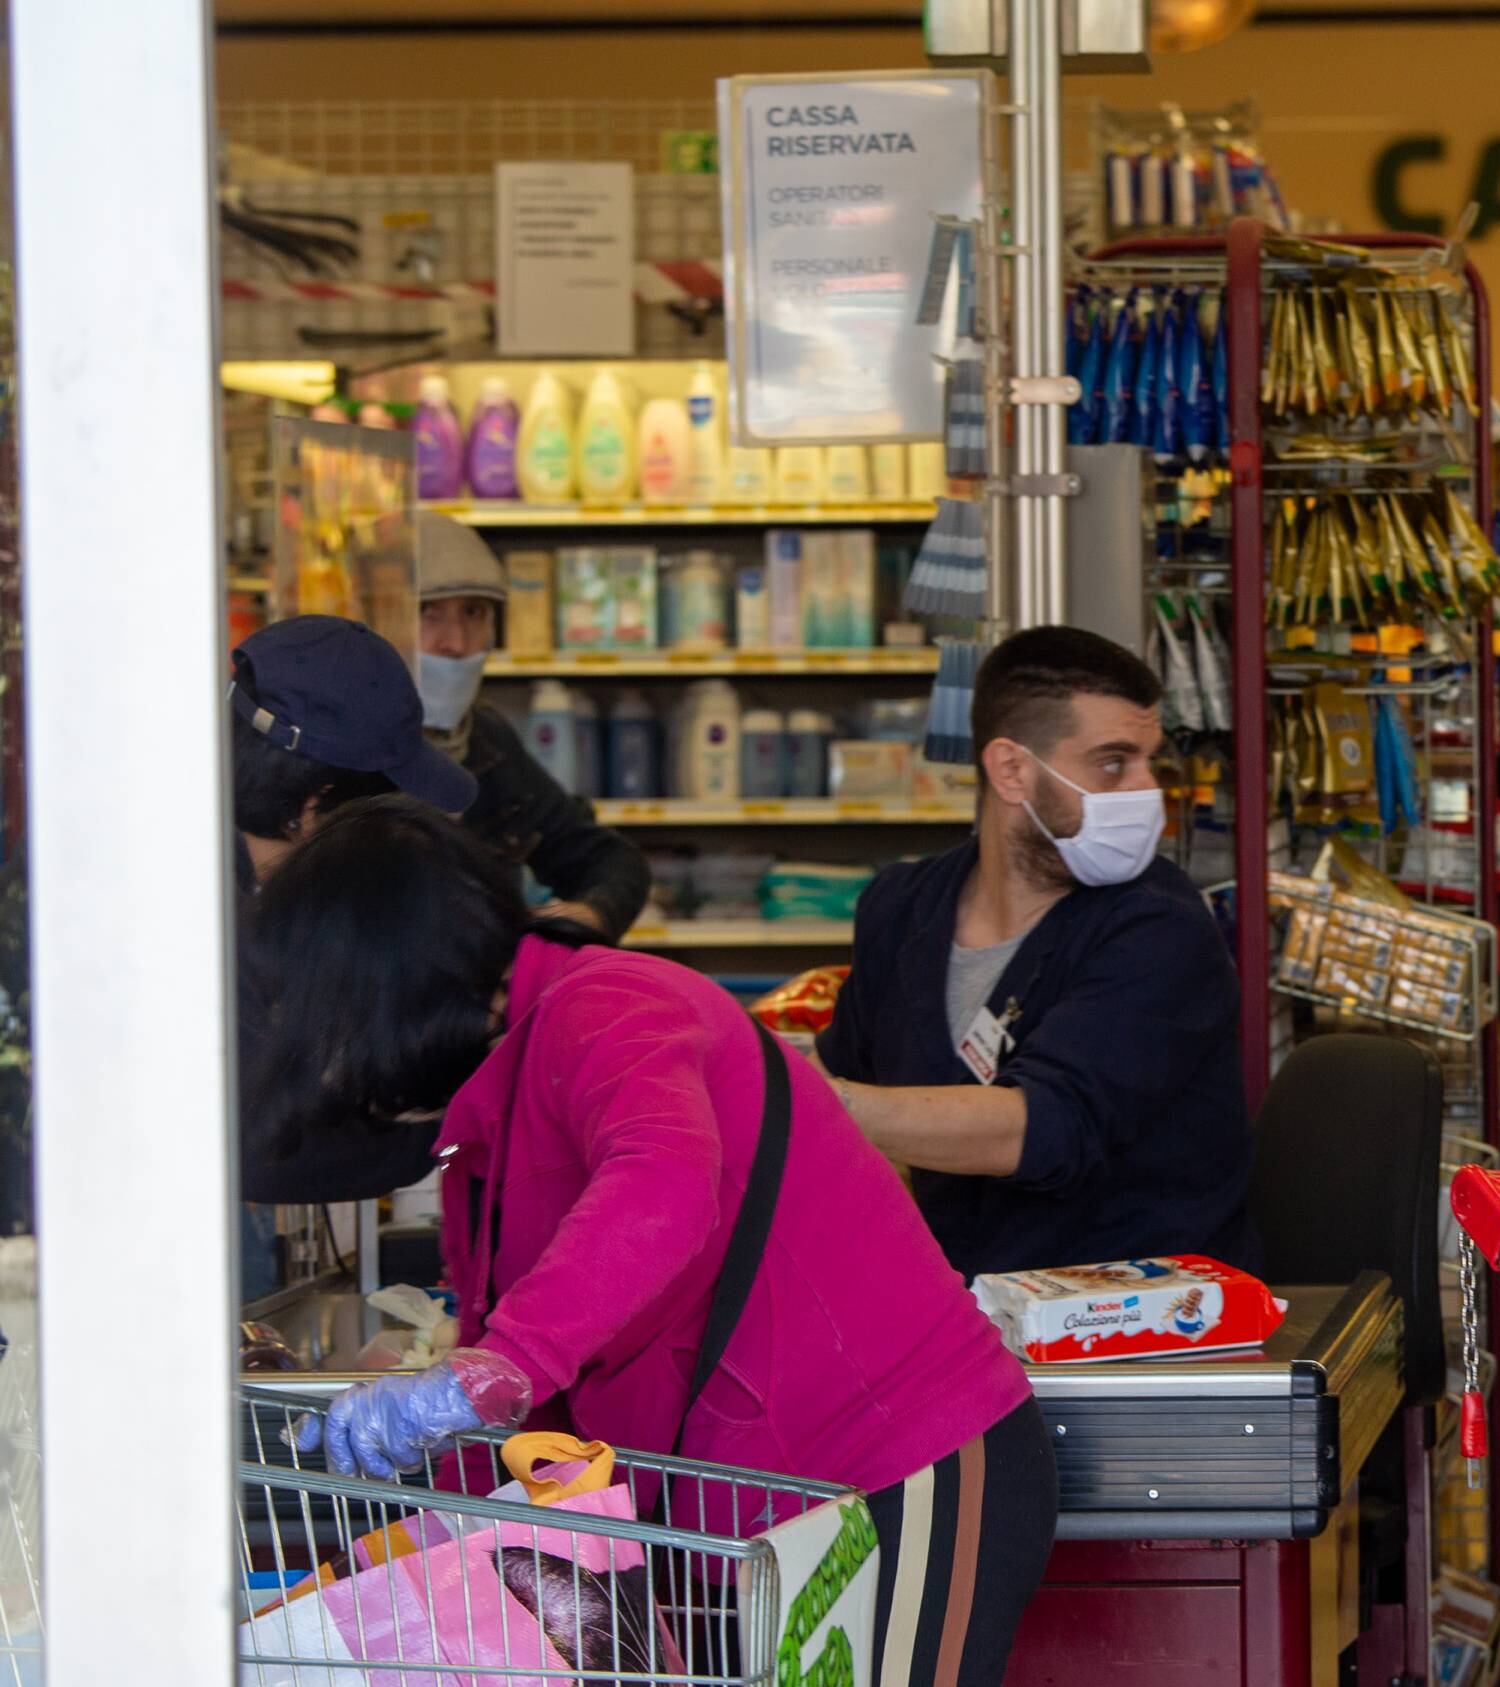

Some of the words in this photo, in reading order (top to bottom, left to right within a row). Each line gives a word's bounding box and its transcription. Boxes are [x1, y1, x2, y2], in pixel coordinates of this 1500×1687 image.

[767, 105, 859, 127] CASSA
[768, 132, 917, 157] RISERVATA
[768, 184, 884, 204] OPERATORI
[771, 256, 892, 276] PERSONALE
